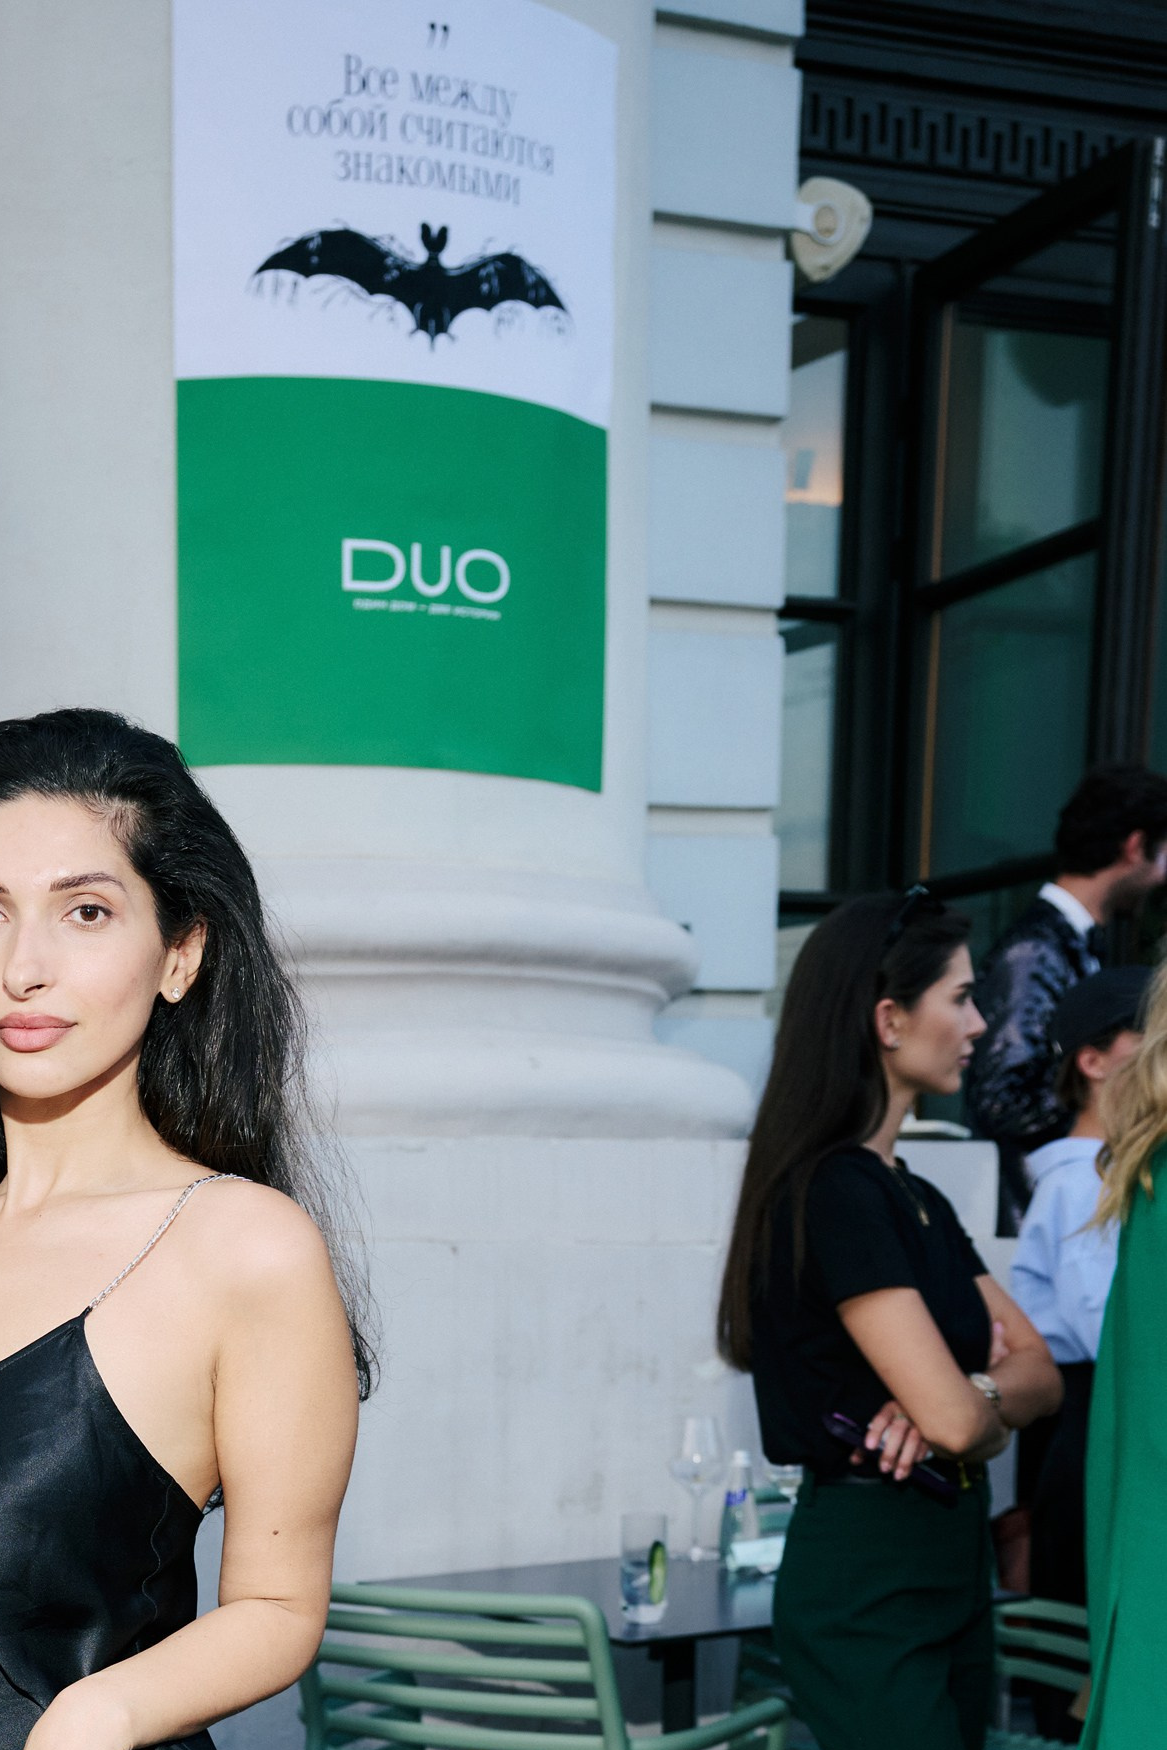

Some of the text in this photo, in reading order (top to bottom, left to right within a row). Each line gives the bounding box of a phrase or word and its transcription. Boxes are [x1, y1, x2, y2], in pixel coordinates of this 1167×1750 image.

[343, 53, 518, 127] Все между
[286, 98, 555, 176] собой считаются
[334, 149, 520, 205] знакомыми
[341, 537, 511, 604] DUO
